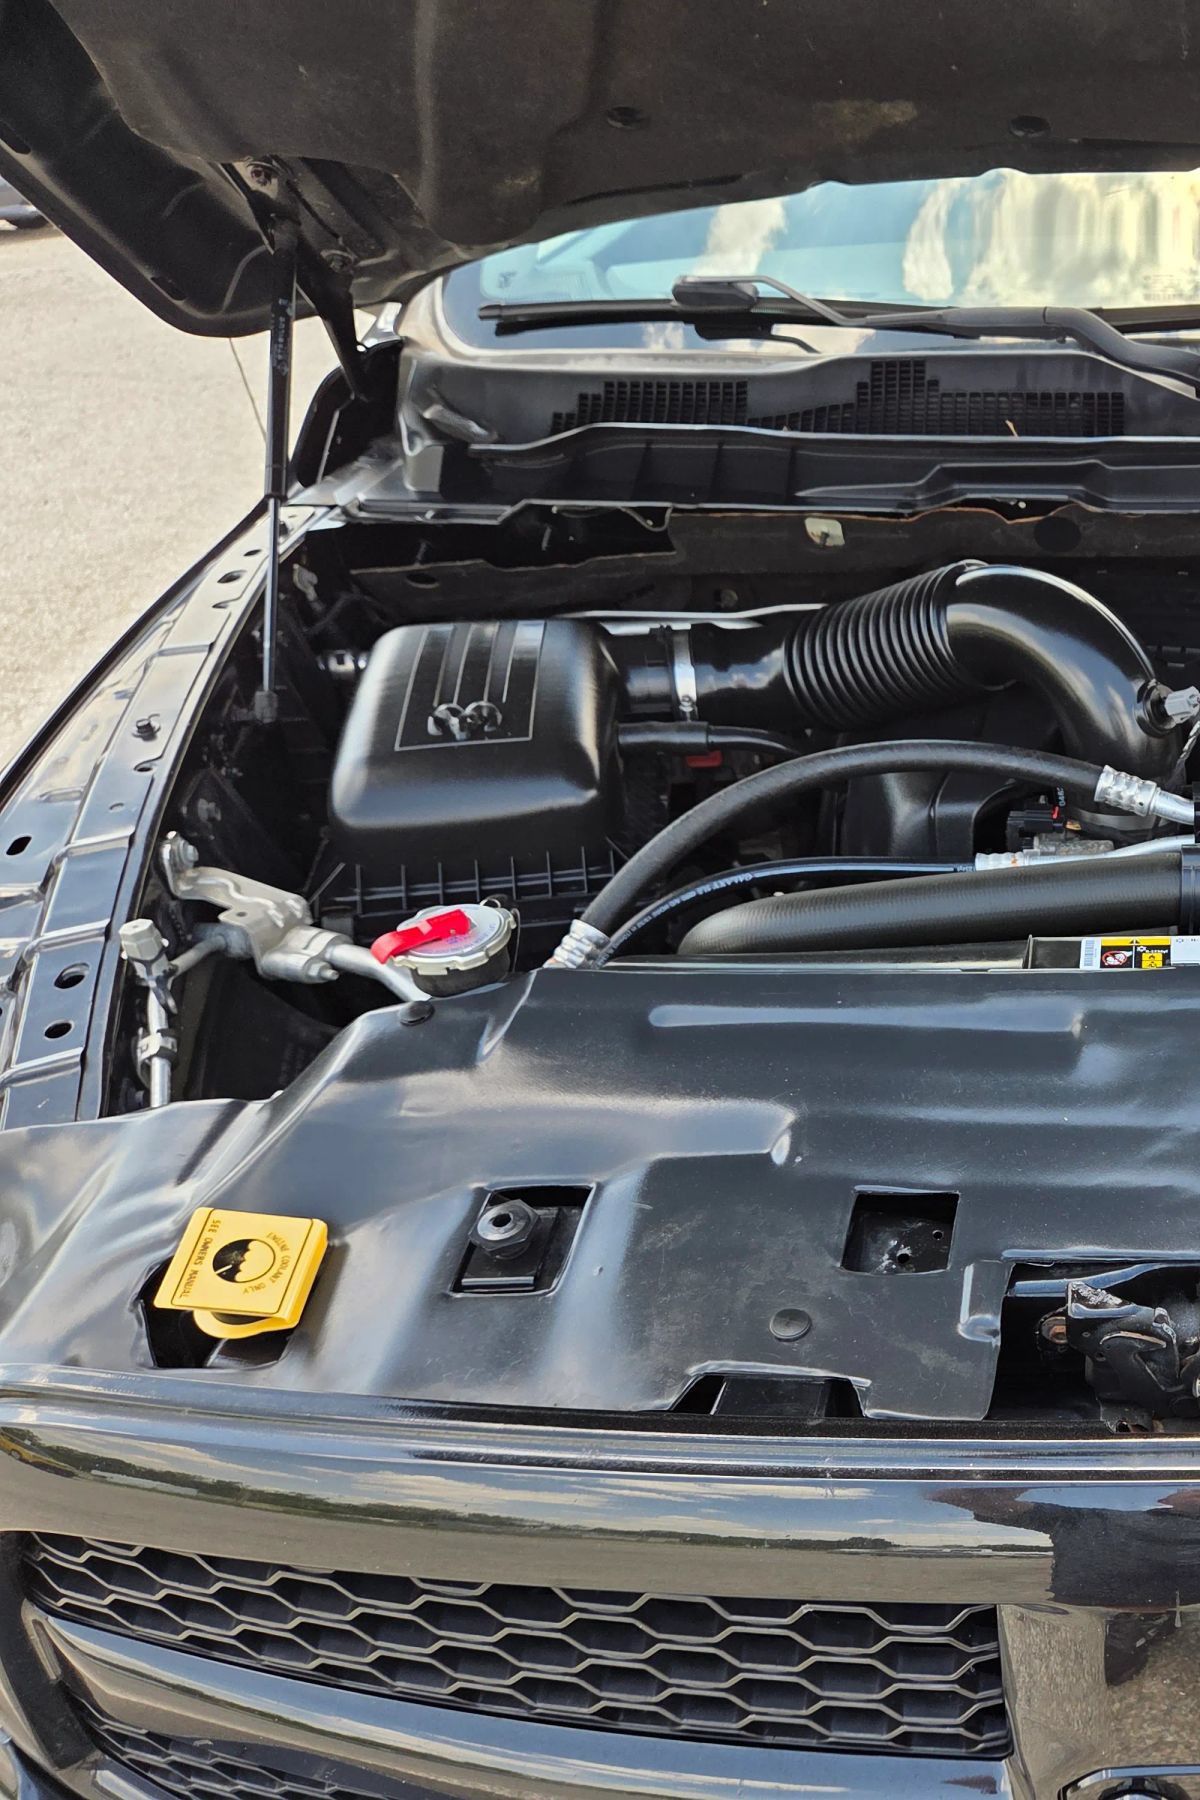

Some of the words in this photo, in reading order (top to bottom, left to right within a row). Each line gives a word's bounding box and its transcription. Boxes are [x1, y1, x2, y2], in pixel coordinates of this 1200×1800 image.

[207, 1219, 222, 1233] SEE
[193, 1237, 213, 1266] OWNERS
[266, 1231, 290, 1253] ENGINE
[269, 1255, 291, 1283] COOLANT
[179, 1269, 199, 1299] MANUAL
[242, 1282, 266, 1296] ONLY
